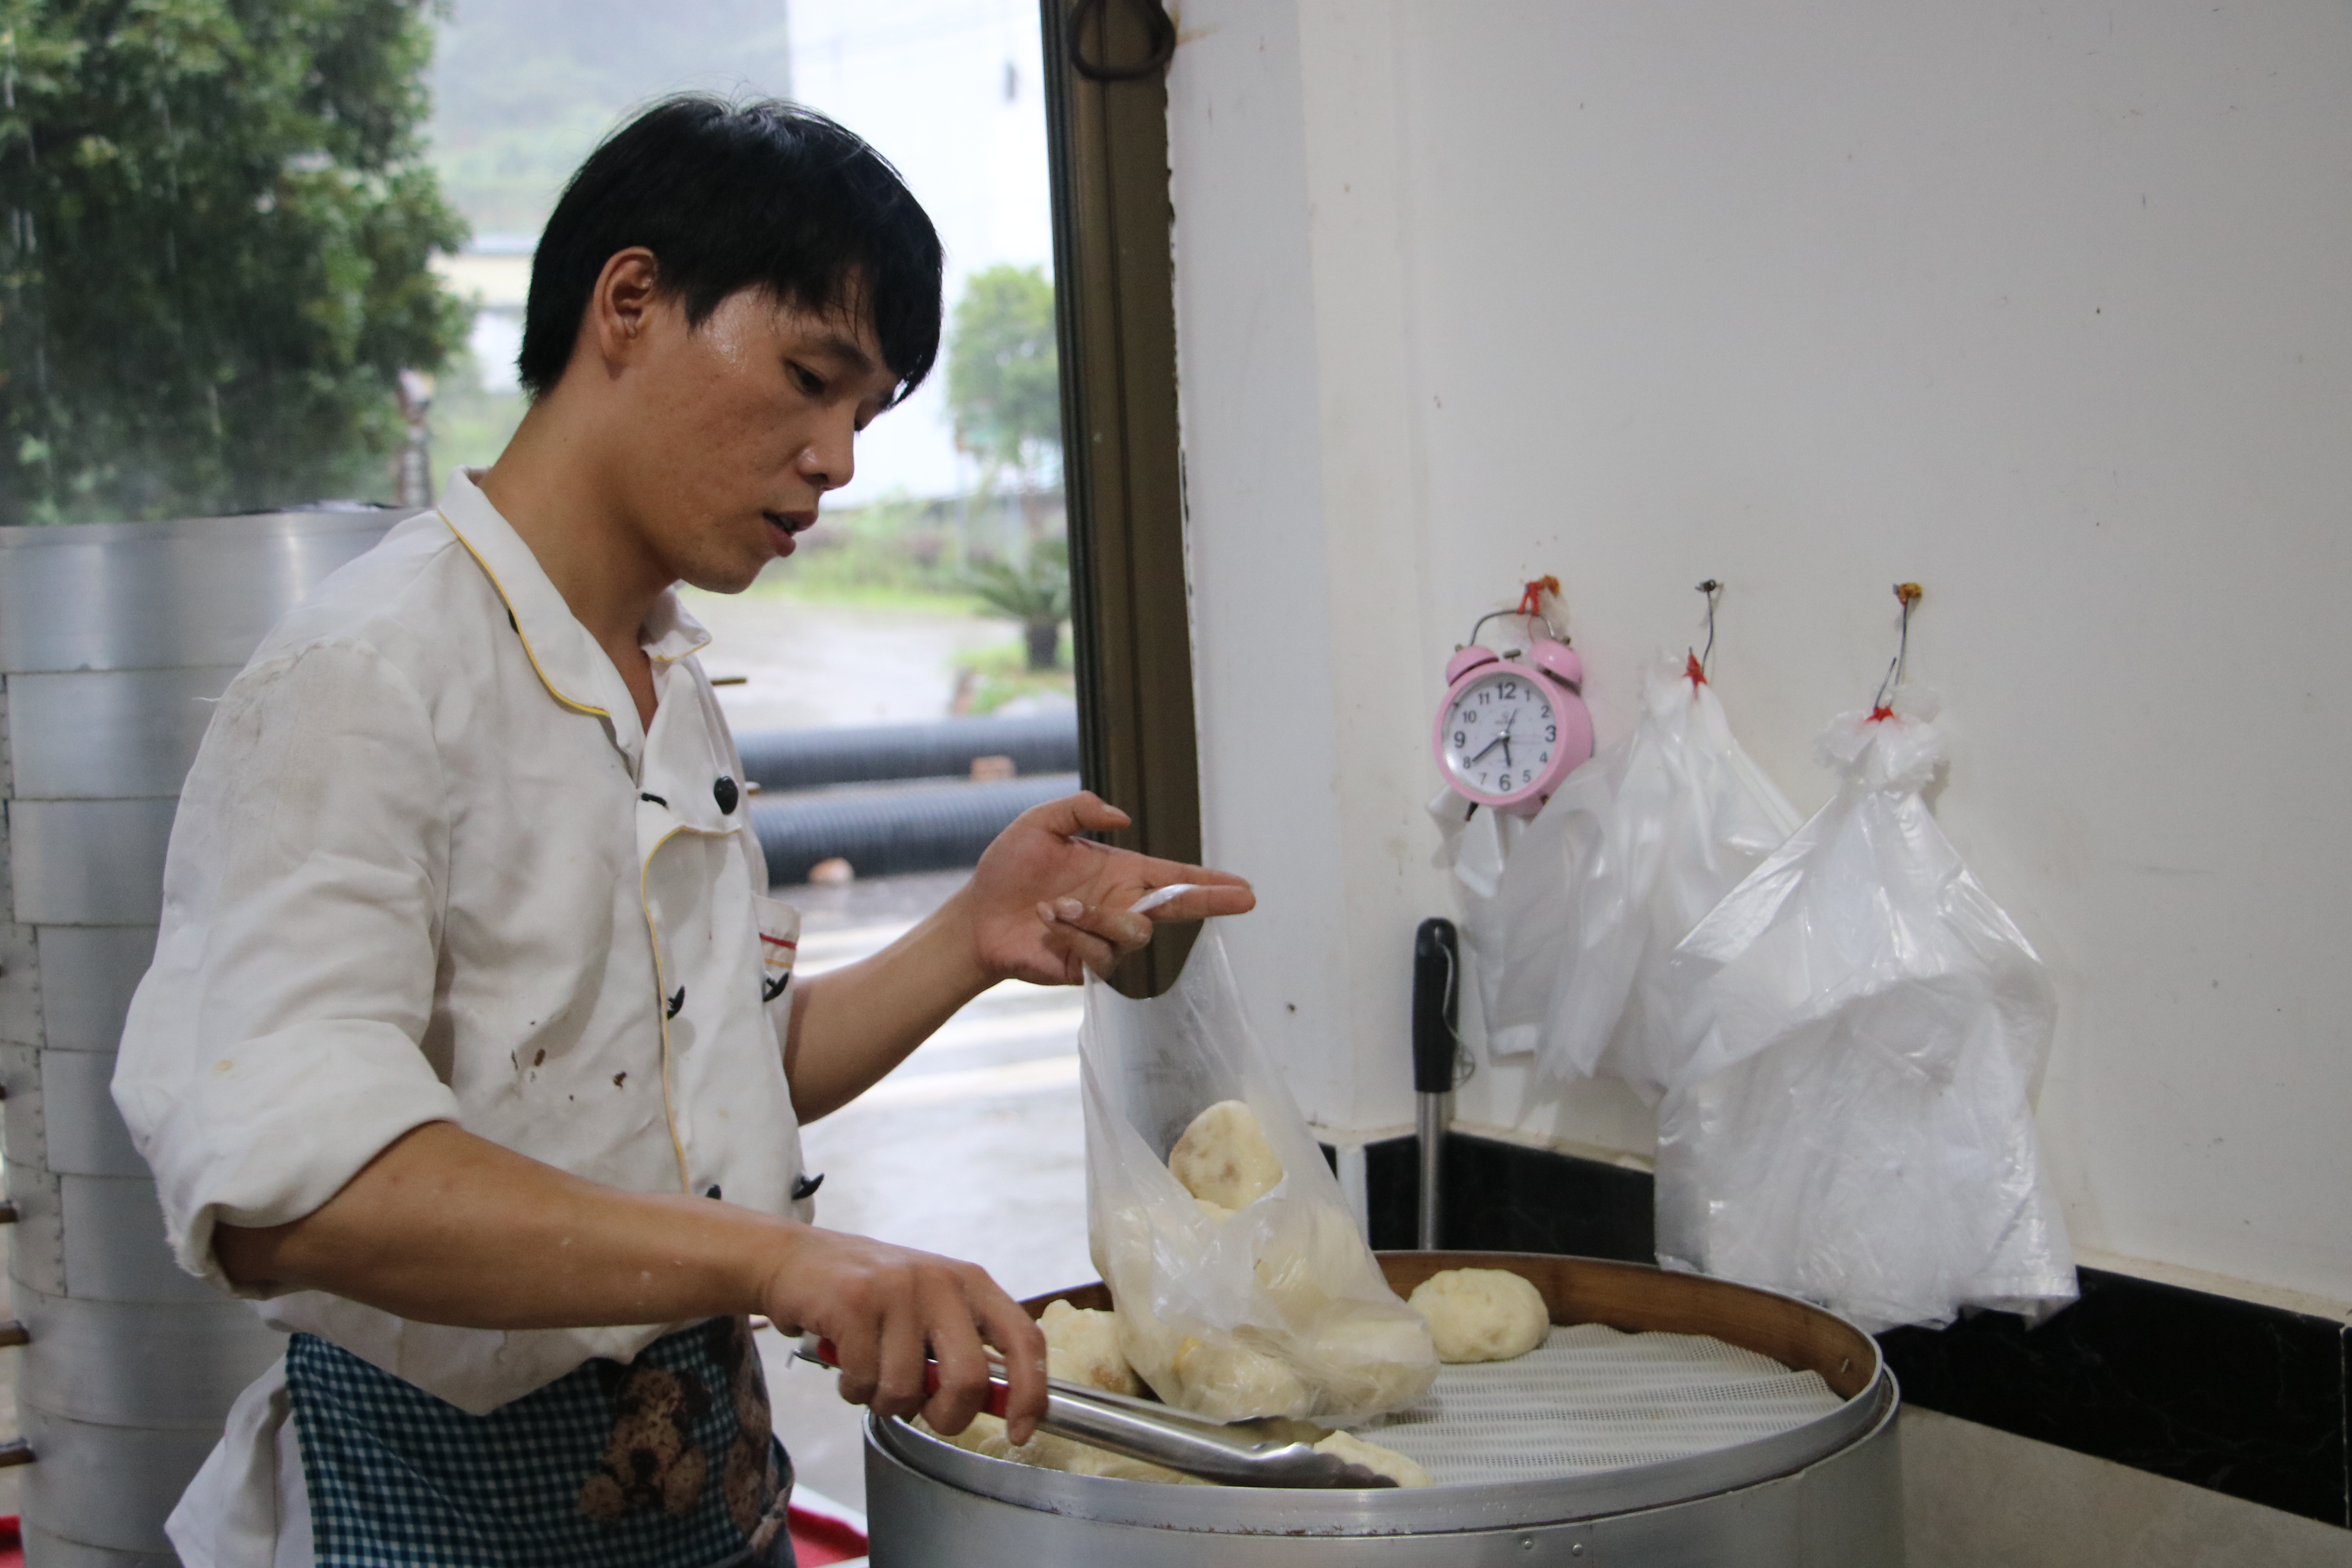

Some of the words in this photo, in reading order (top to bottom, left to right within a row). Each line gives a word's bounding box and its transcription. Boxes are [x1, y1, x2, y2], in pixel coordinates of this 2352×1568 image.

[1497, 682, 1516, 700] 12
[1525, 690, 1530, 701] 1
[1478, 692, 1489, 705] 11
[1464, 711, 1476, 723] 10
[1541, 705, 1550, 718] 2
[1453, 731, 1465, 748] 9
[1545, 725, 1556, 742] 3
[1464, 756, 1471, 769] 8
[1540, 752, 1547, 763] 4
[1479, 772, 1487, 784] 7
[1500, 775, 1511, 791] 6
[1523, 770, 1531, 783] 5
